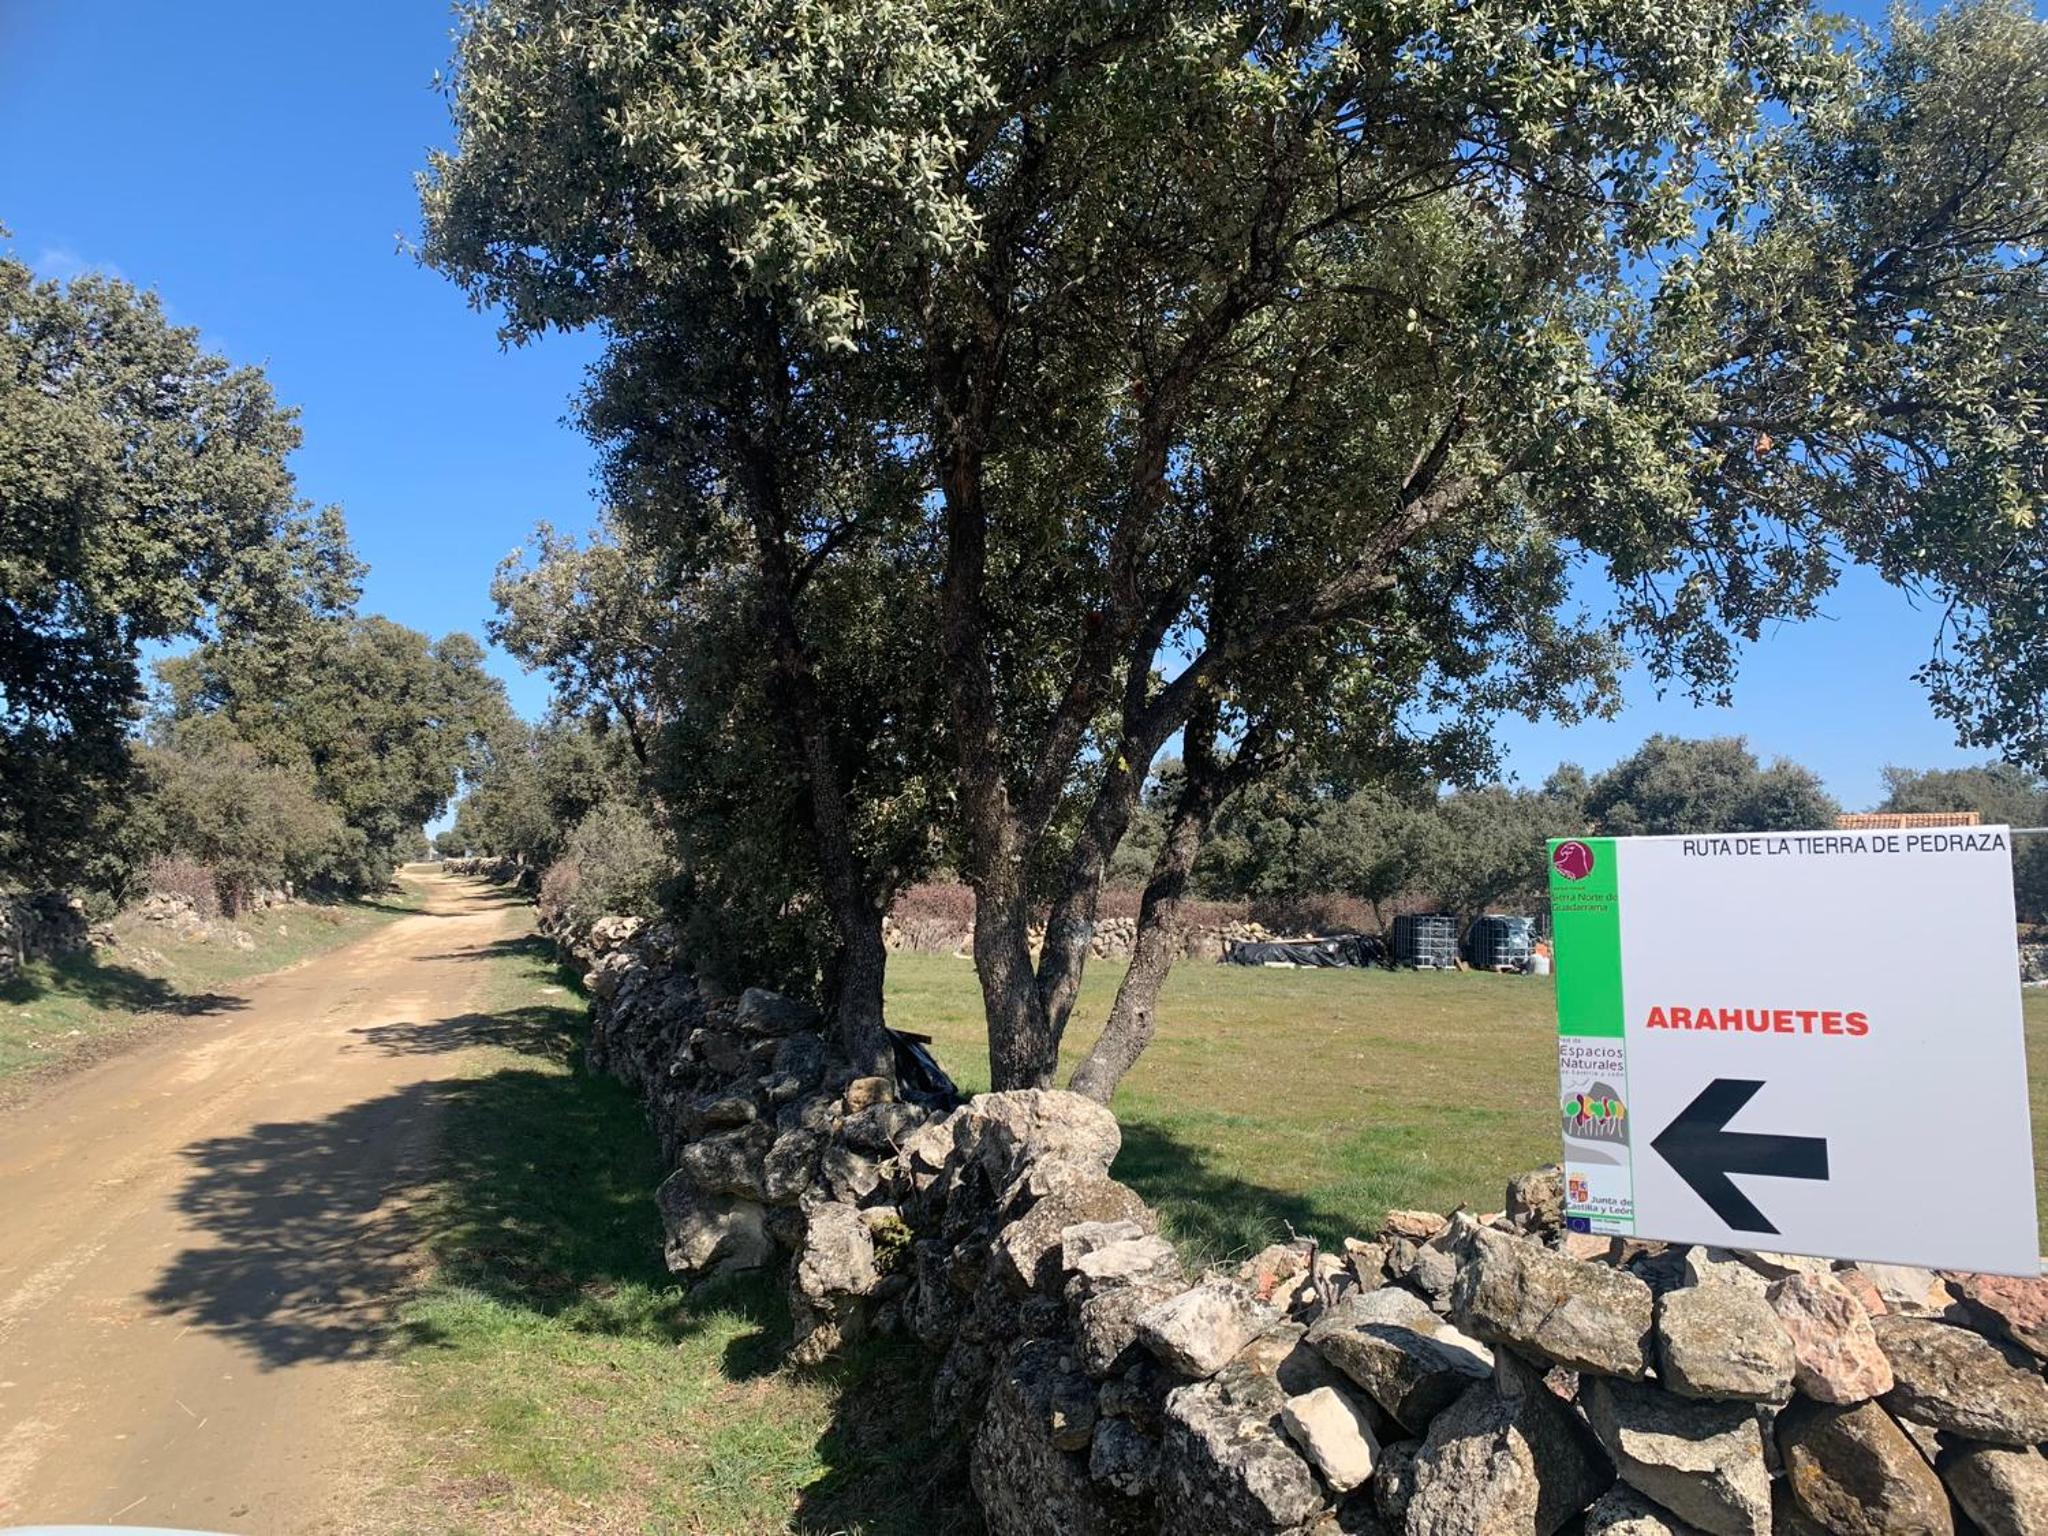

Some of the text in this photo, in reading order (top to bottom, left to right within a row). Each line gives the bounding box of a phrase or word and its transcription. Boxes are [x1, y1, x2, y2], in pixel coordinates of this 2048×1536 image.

[1683, 833, 2006, 856] RUTA DE LA TIERRA DE PEDRAZA
[1646, 1006, 1870, 1037] ARAHUETES
[1560, 1045, 1623, 1059] Espacios
[1561, 1057, 1624, 1071] Naturales
[1591, 1196, 1618, 1205] Junta
[1601, 1206, 1606, 1214] y
